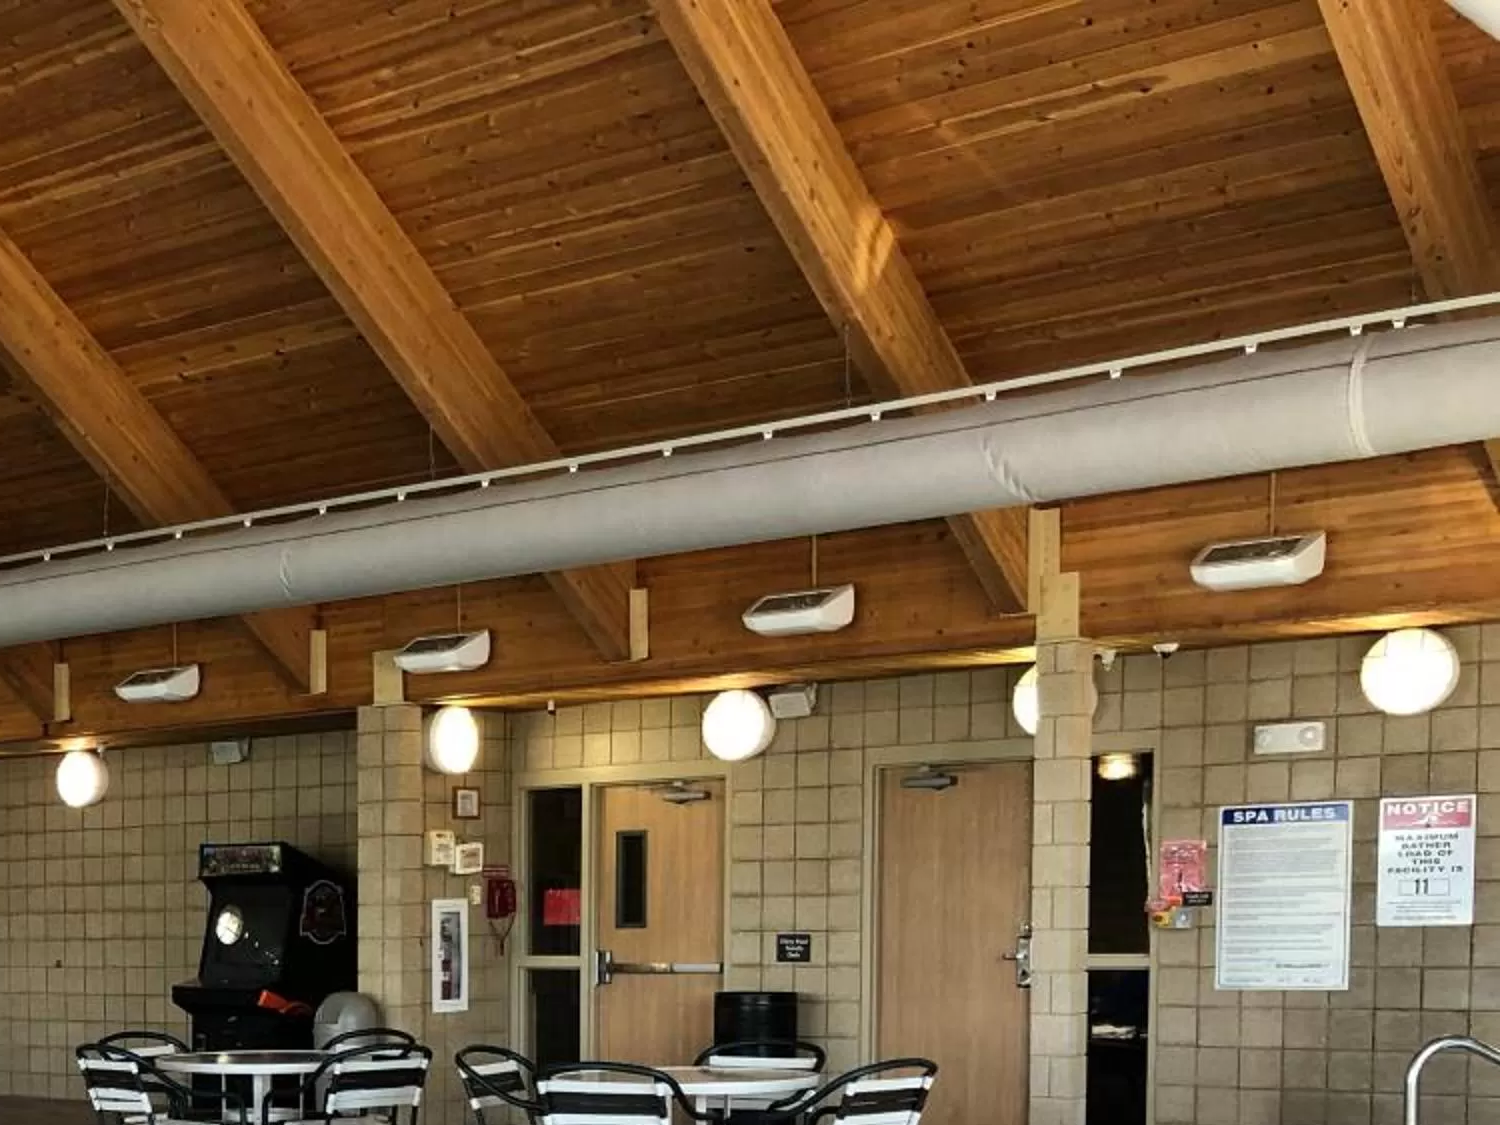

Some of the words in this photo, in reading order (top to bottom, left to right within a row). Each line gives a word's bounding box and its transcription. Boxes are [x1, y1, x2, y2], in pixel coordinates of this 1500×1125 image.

[1233, 810, 1269, 823] SPA
[1274, 807, 1337, 821] RULES
[1387, 801, 1469, 815] NOTICE
[1415, 878, 1429, 895] 11
